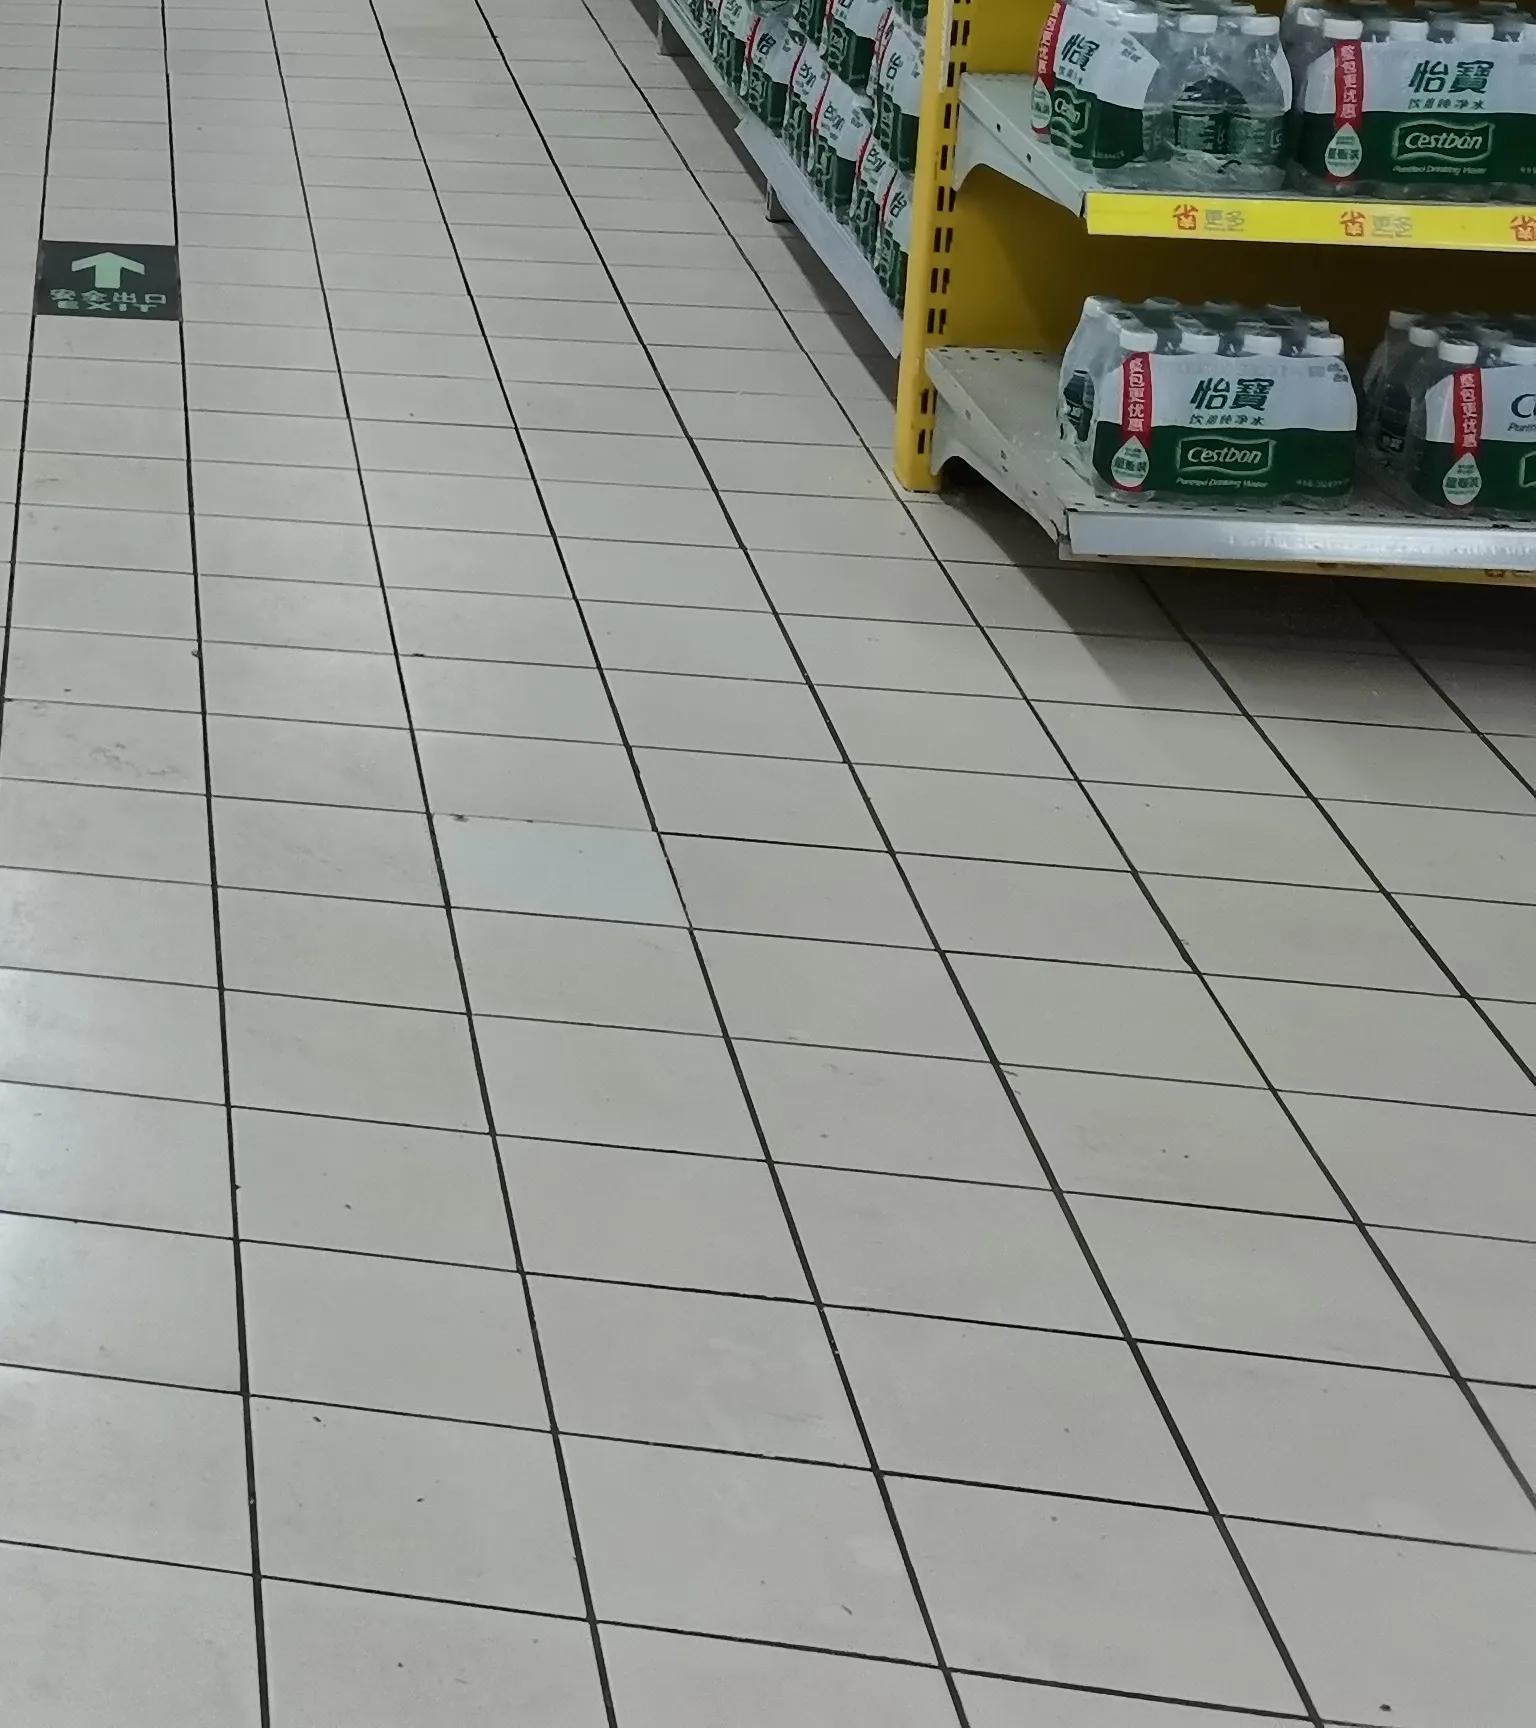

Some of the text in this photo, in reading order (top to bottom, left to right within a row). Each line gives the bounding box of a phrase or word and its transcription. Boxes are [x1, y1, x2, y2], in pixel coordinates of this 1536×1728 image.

[1408, 60, 1494, 94] 怡寶
[50, 289, 167, 304] 安全出口
[1127, 357, 1145, 432] 整包更优惠
[1190, 378, 1276, 411] 怡寶
[1460, 372, 1478, 449] 整包更优惠
